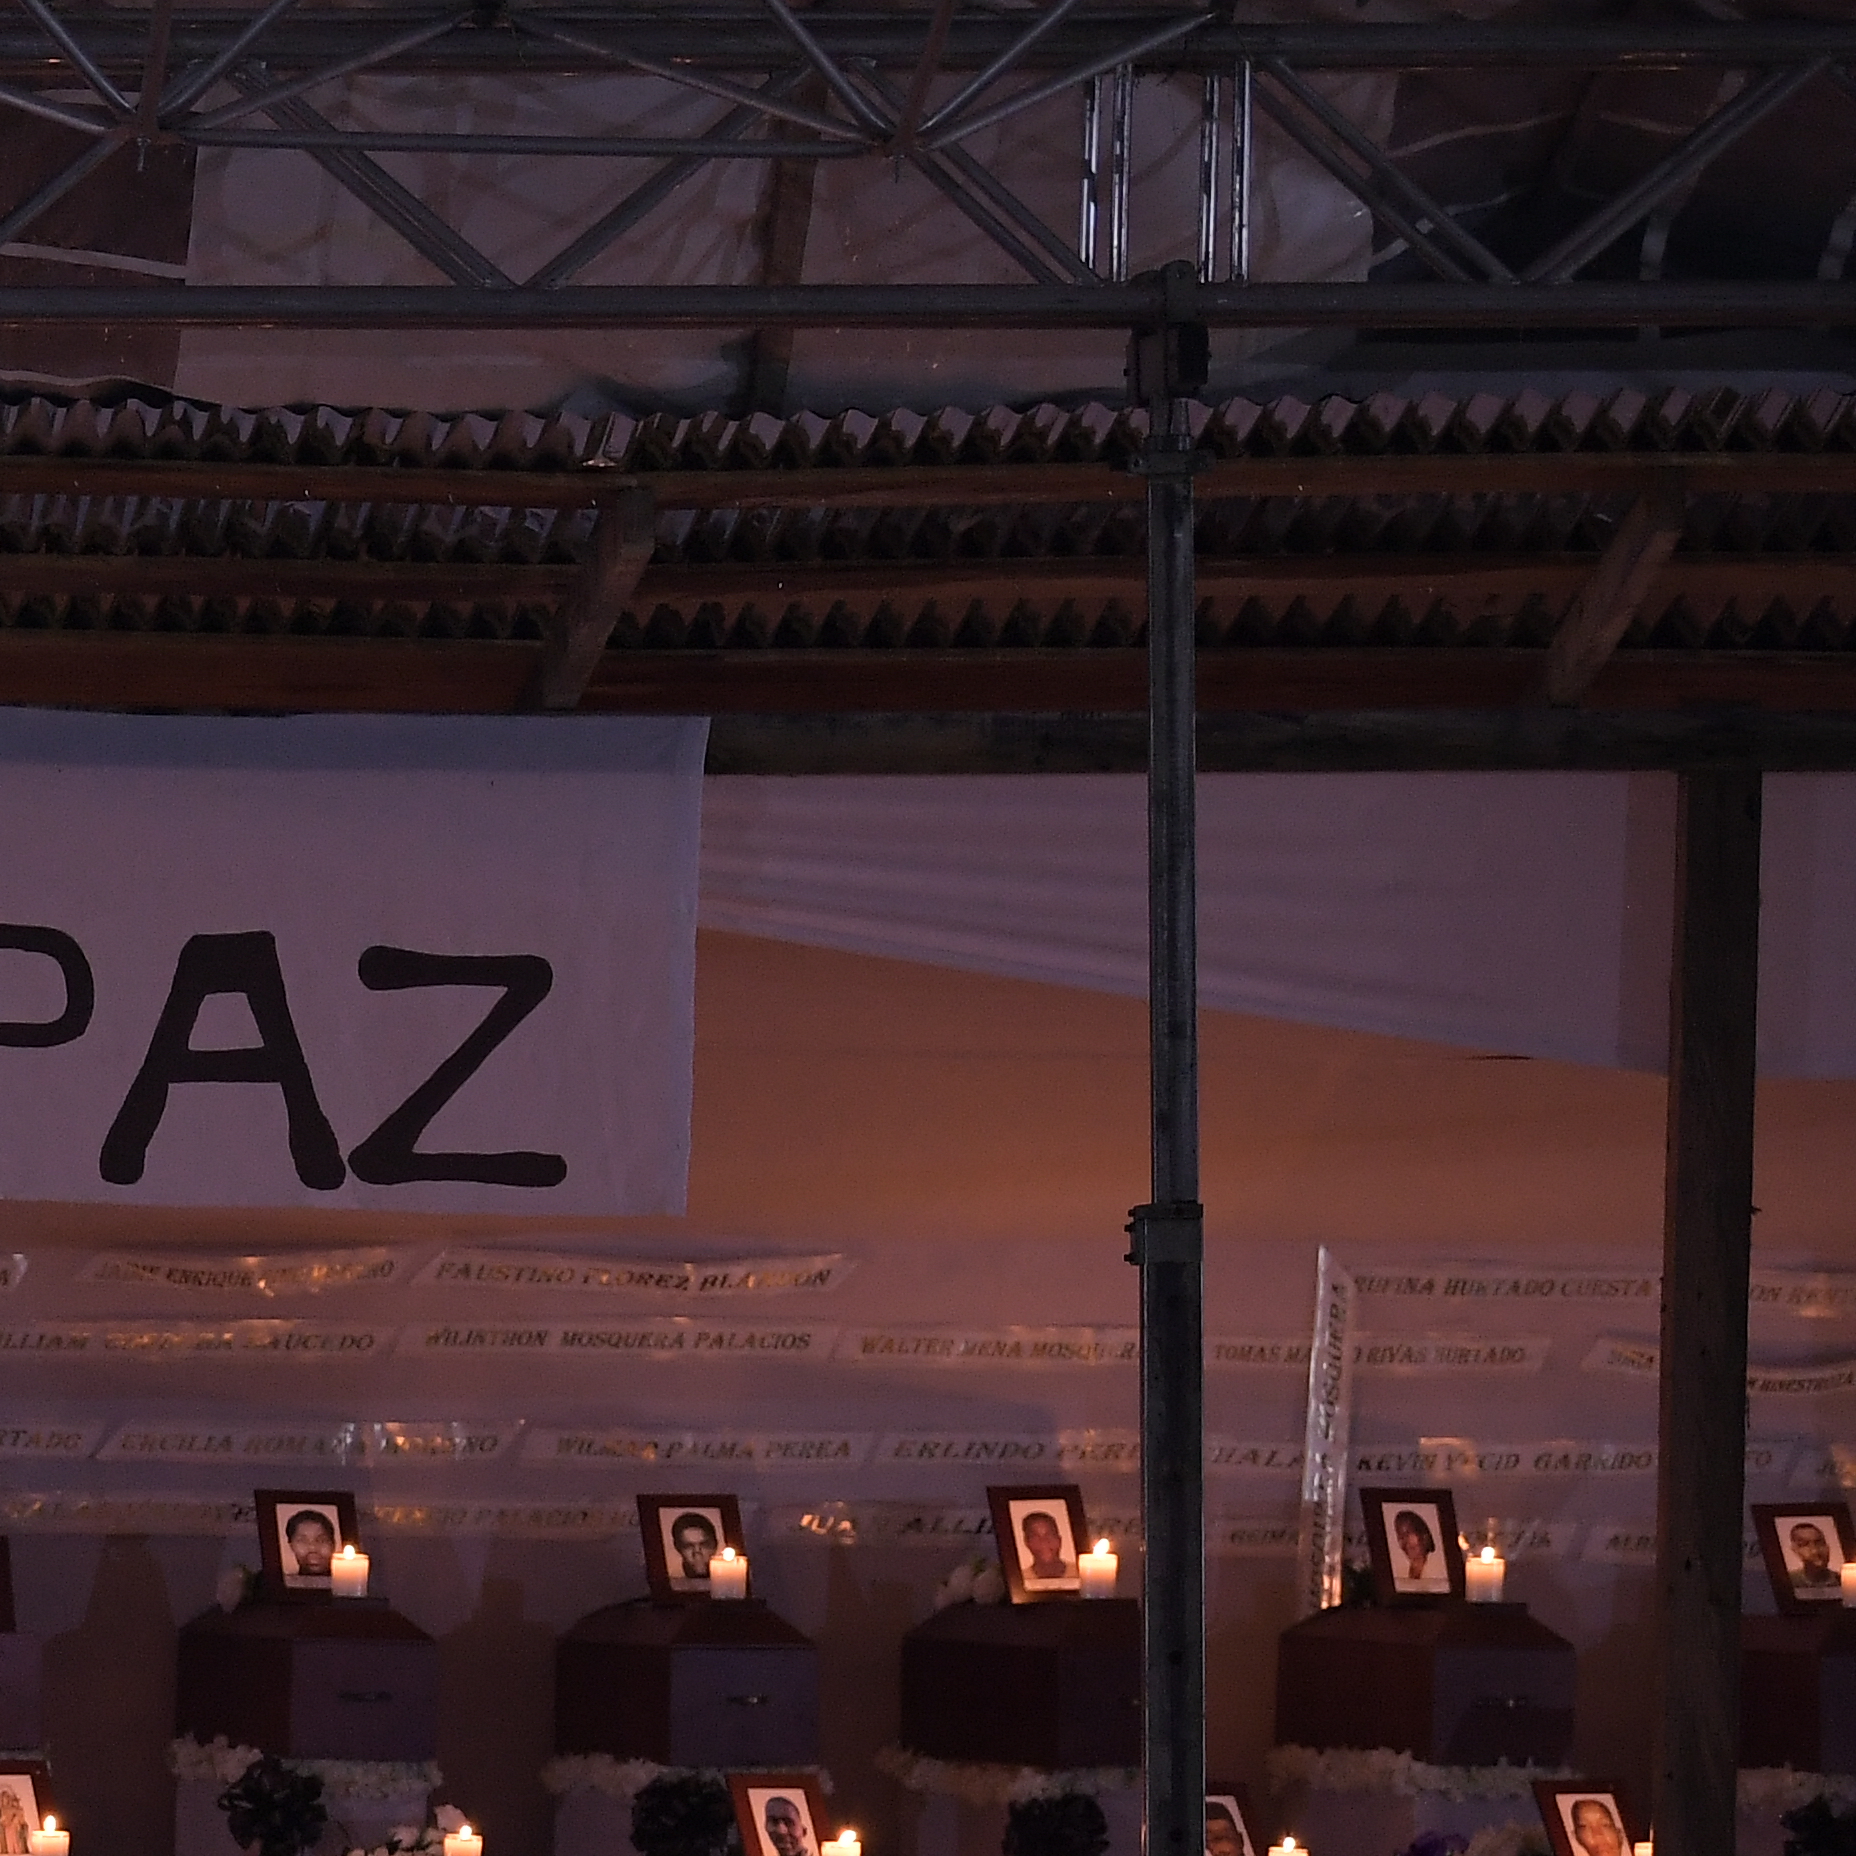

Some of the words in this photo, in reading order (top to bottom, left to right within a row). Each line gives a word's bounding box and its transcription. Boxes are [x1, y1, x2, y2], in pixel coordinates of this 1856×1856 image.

[165, 1264, 252, 1288] ENRIQUE
[436, 1260, 575, 1284] FAUSTINO
[1443, 1277, 1555, 1298] HURTADO
[1561, 1277, 1652, 1298] CUESTA
[560, 1331, 685, 1350] MOSQUERA
[692, 1332, 812, 1350] PALACIOS
[860, 1335, 952, 1356] WALTER
[959, 1337, 1024, 1358] MENA
[1214, 1344, 1281, 1364] TOMAS
[1365, 1345, 1426, 1366] RIVAS
[1434, 1346, 1526, 1367] HURTADO
[764, 1439, 852, 1459] PEREA
[893, 1439, 1045, 1460] ERLINDO
[1357, 1453, 1438, 1472] KEVIN
